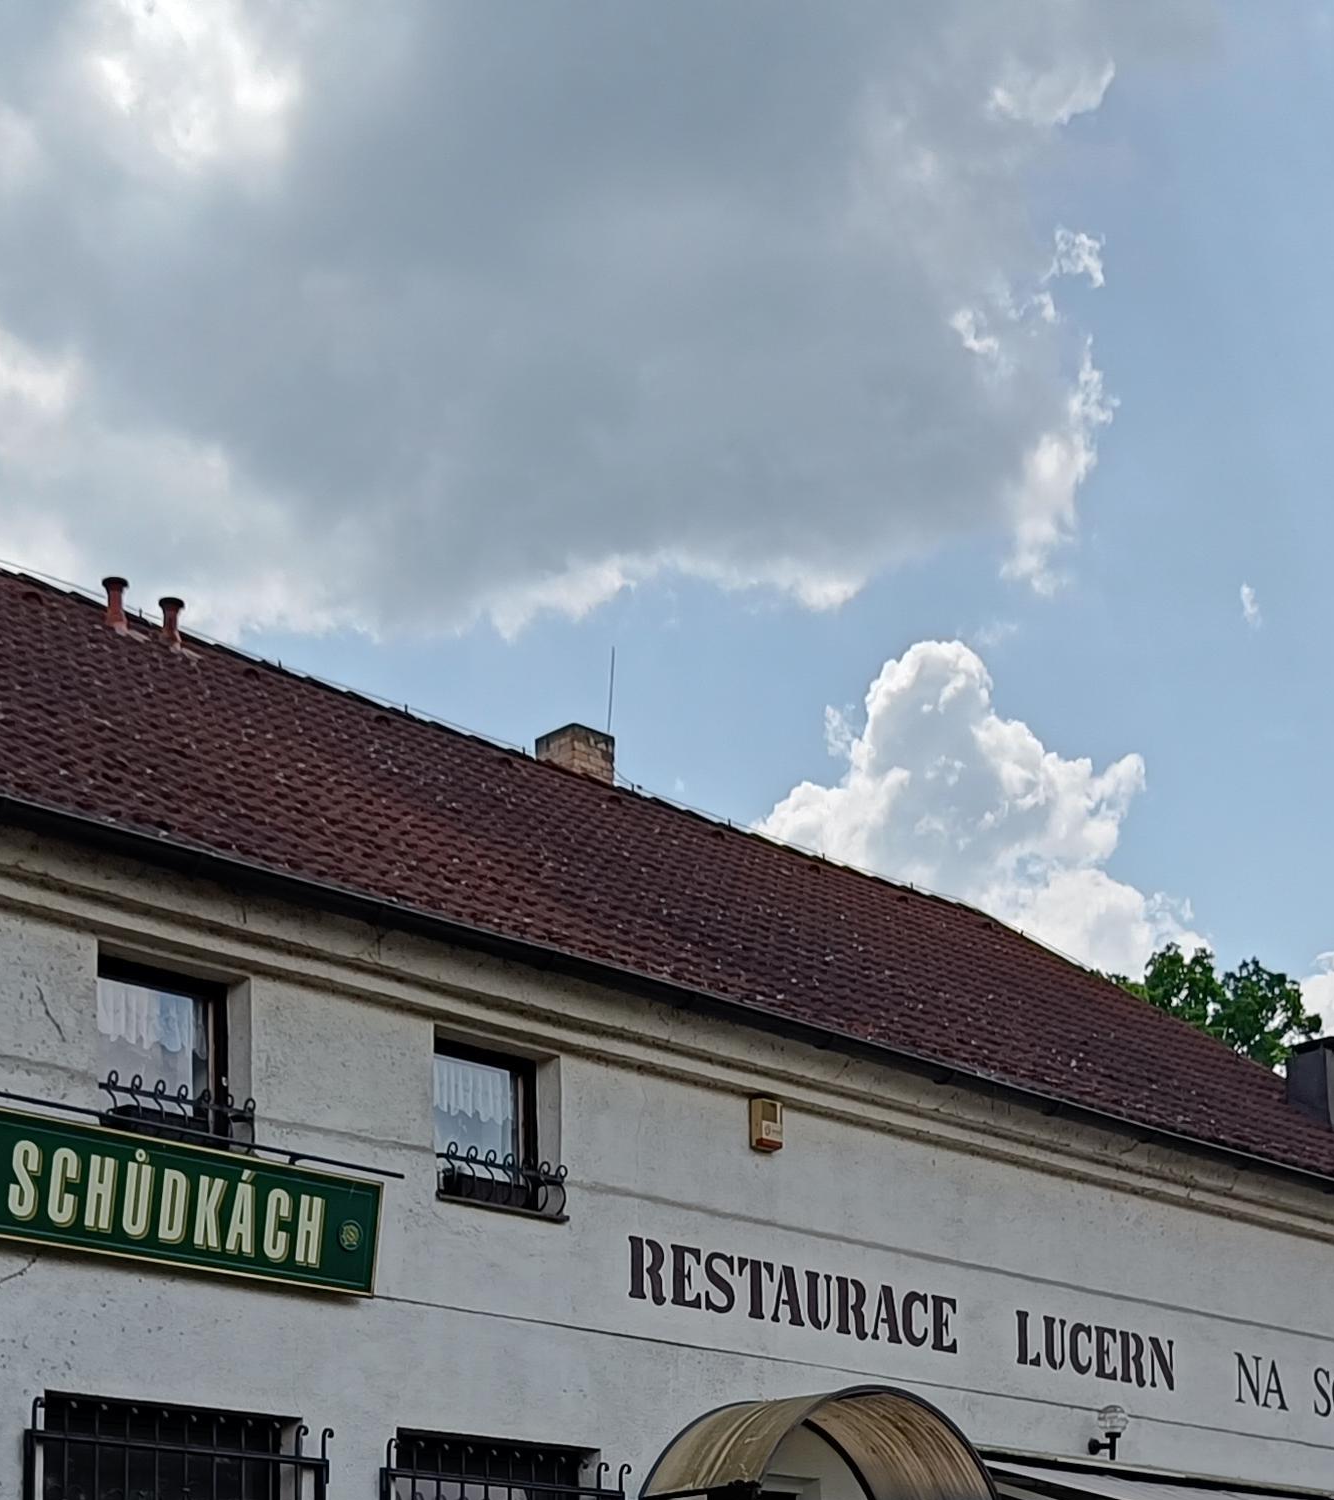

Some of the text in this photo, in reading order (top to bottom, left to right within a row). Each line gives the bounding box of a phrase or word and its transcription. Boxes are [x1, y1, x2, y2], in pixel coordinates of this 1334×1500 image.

[8, 1140, 326, 1268] SCHŮDKÁCH
[628, 1235, 958, 1355] RESTAURACE
[1016, 1310, 1175, 1391] LUCERN
[1235, 1352, 1288, 1411] NA
